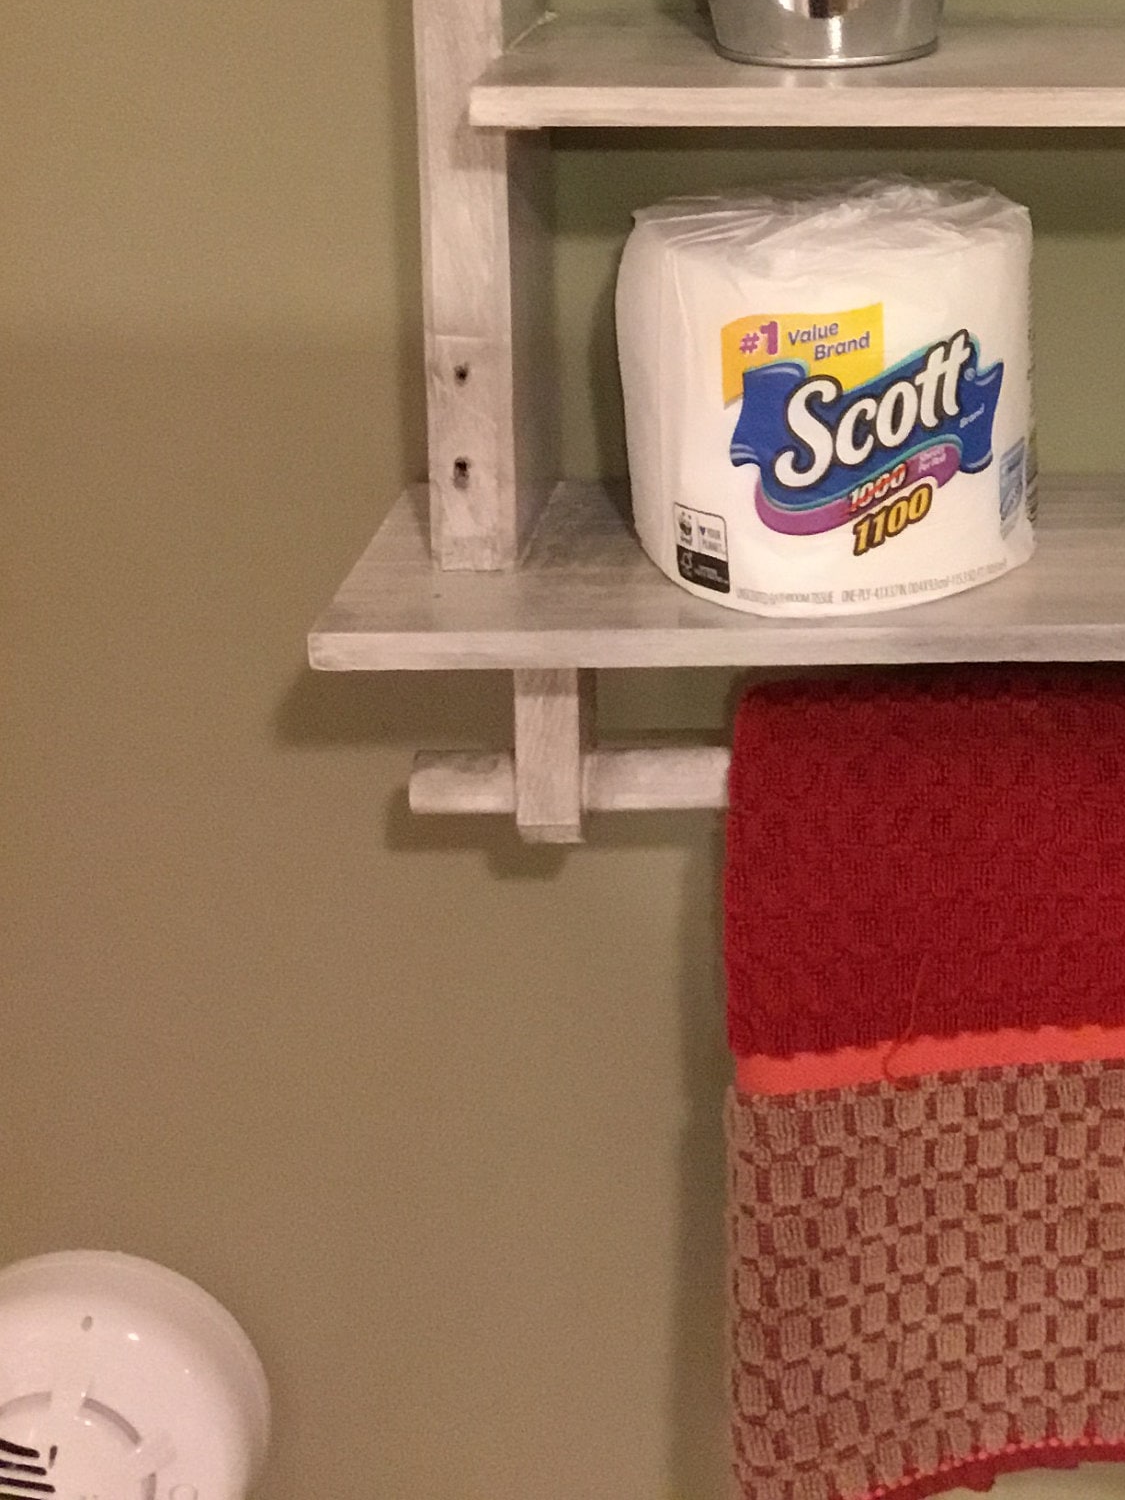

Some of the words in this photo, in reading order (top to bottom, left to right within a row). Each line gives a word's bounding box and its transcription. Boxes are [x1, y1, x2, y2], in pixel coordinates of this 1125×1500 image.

[739, 320, 779, 356] #1
[787, 322, 839, 346] Value
[814, 331, 870, 361] Brand
[772, 329, 972, 490] Scott
[849, 463, 908, 512] 1000
[852, 482, 933, 556] 1100
